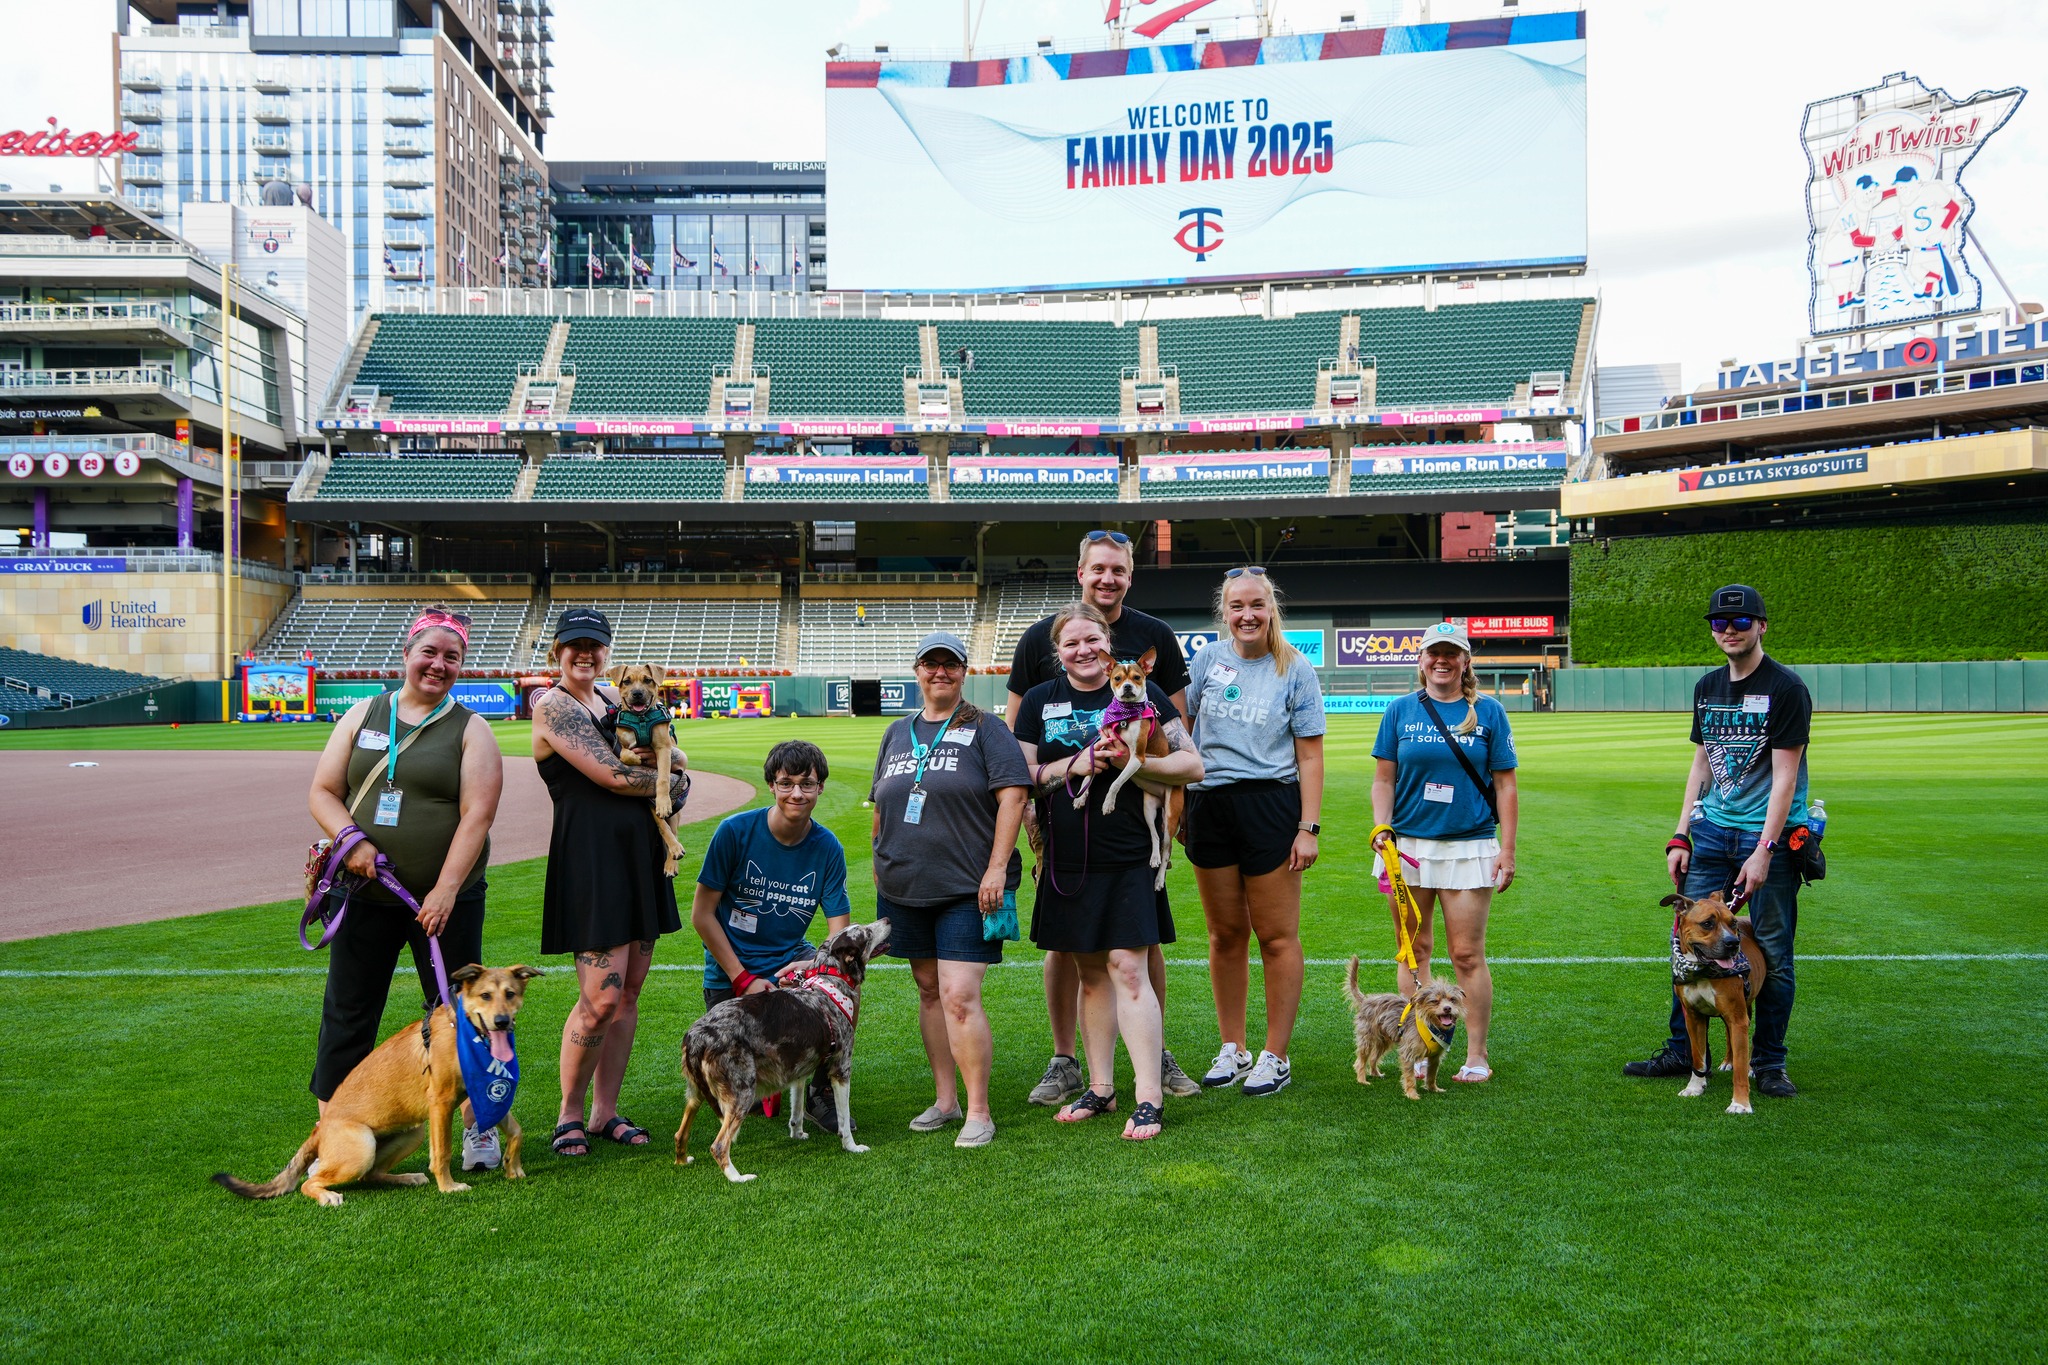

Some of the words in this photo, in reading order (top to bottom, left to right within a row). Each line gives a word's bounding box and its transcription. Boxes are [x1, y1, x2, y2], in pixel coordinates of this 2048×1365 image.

[1127, 100, 1235, 130] WELCOME
[1242, 98, 1268, 121] TO
[1823, 130, 1883, 177] Win!
[1887, 114, 1980, 151] Twins!
[1066, 131, 1170, 189] FAMILY
[1179, 127, 1239, 182] DAY
[1247, 120, 1334, 178] 2025
[1717, 344, 1895, 389] TARGET
[393, 421, 448, 433] Treasure
[451, 421, 488, 433] Island
[791, 423, 845, 434] Treasure
[847, 423, 883, 434] Island
[1200, 420, 1253, 432] Treasure
[1254, 418, 1292, 430] Island
[15, 460, 26, 471] 14
[52, 459, 59, 470] 6
[84, 459, 98, 470] 29
[123, 458, 130, 469] 3
[1411, 458, 1461, 473] Home
[1466, 457, 1499, 471] Run
[1504, 454, 1548, 470] Deck
[787, 469, 861, 483] Treasure
[864, 469, 914, 483] Island
[986, 469, 1034, 483] Home
[1038, 469, 1069, 483] Run
[1073, 468, 1114, 483] Deck
[1186, 466, 1258, 480] Treasure
[1262, 463, 1313, 478] Island
[1718, 469, 1763, 484] DELTA
[13, 563, 51, 572] GRAY
[54, 563, 92, 572] DUCK
[110, 600, 157, 614] United
[111, 615, 186, 628] Healthcare
[1488, 618, 1503, 628] HIT
[1504, 618, 1522, 628] THE
[1523, 617, 1549, 628] BUDS
[456, 695, 504, 703] PENTAIR
[1324, 700, 1353, 708] GREAT
[1404, 722, 1423, 732] tell
[889, 752, 911, 762] RUFF
[750, 876, 766, 885] tell
[768, 880, 790, 890] your
[791, 884, 809, 894] cat
[743, 886, 765, 898] said
[766, 891, 816, 907] pspspsps
[1397, 883, 1406, 904] ADOPT
